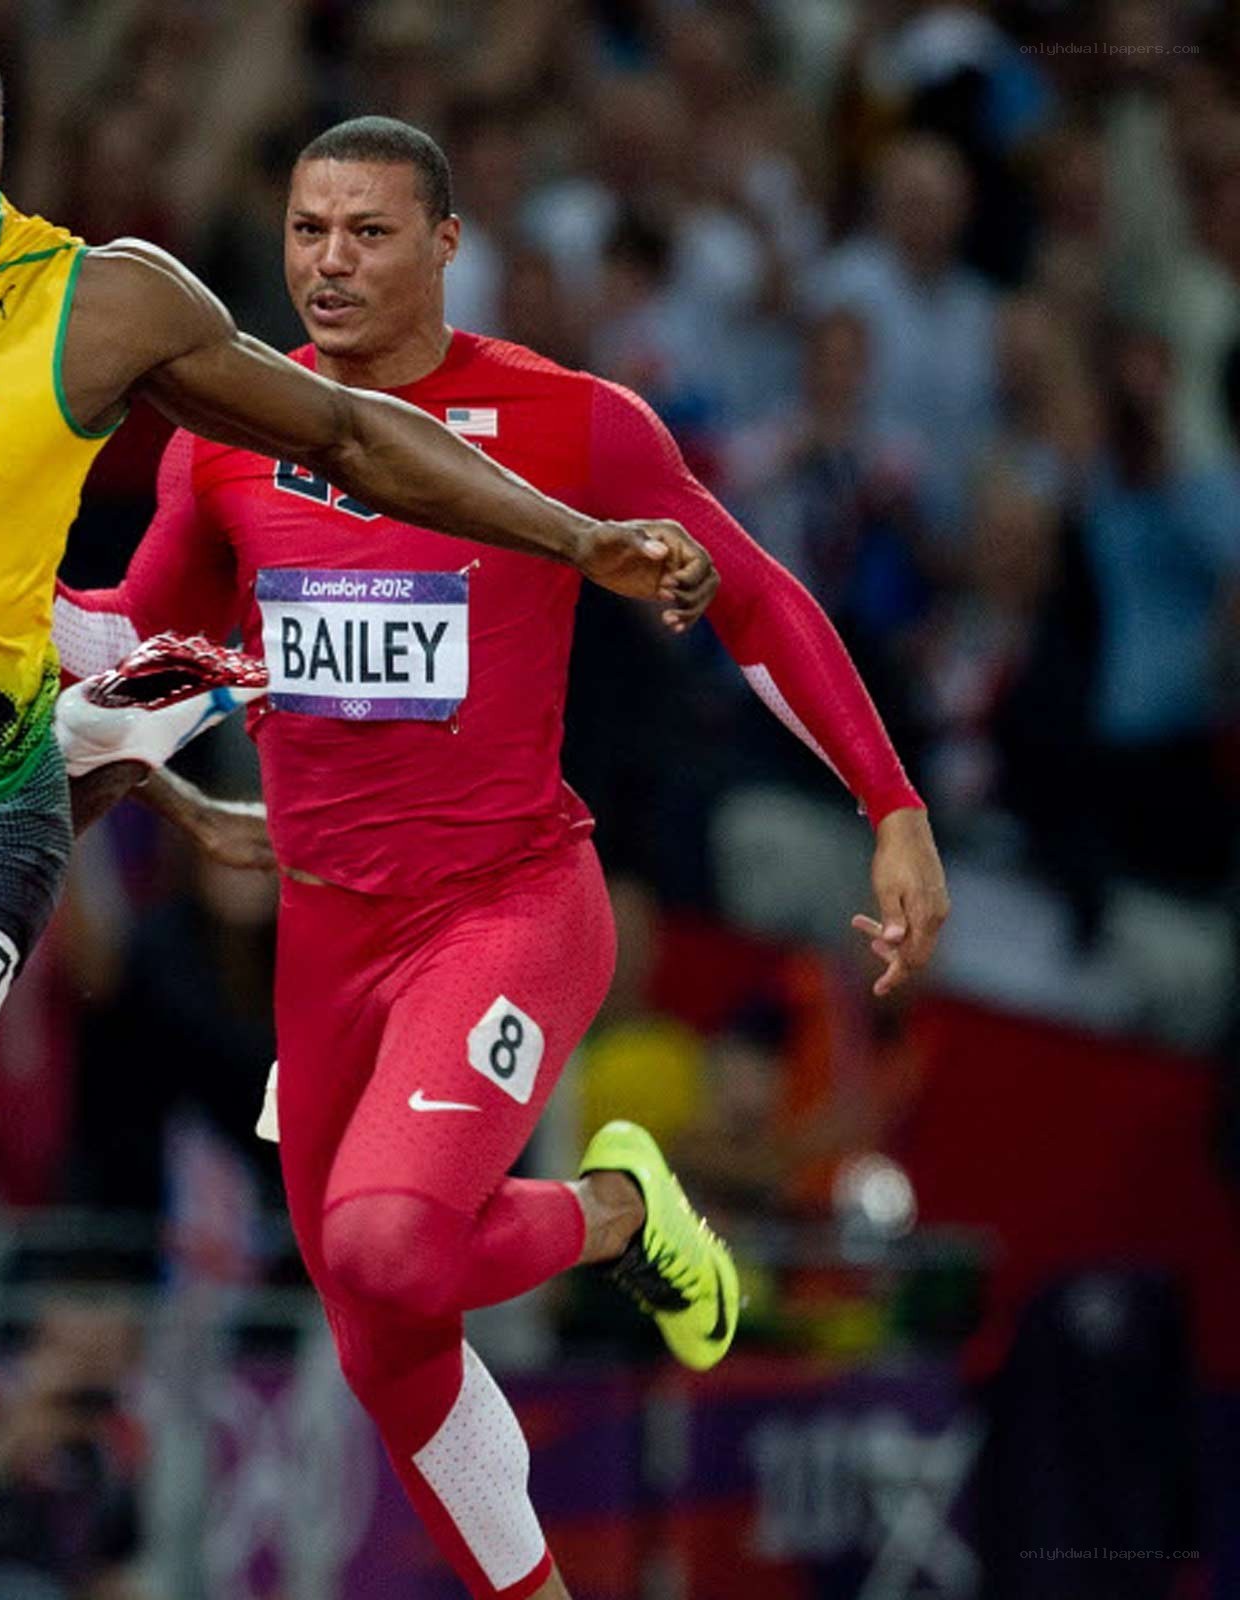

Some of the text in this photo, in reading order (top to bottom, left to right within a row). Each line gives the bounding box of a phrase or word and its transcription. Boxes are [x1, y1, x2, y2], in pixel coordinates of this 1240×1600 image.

[301, 576, 414, 598] London 2012
[281, 616, 449, 684] BAILEY
[488, 1014, 524, 1080] 8
